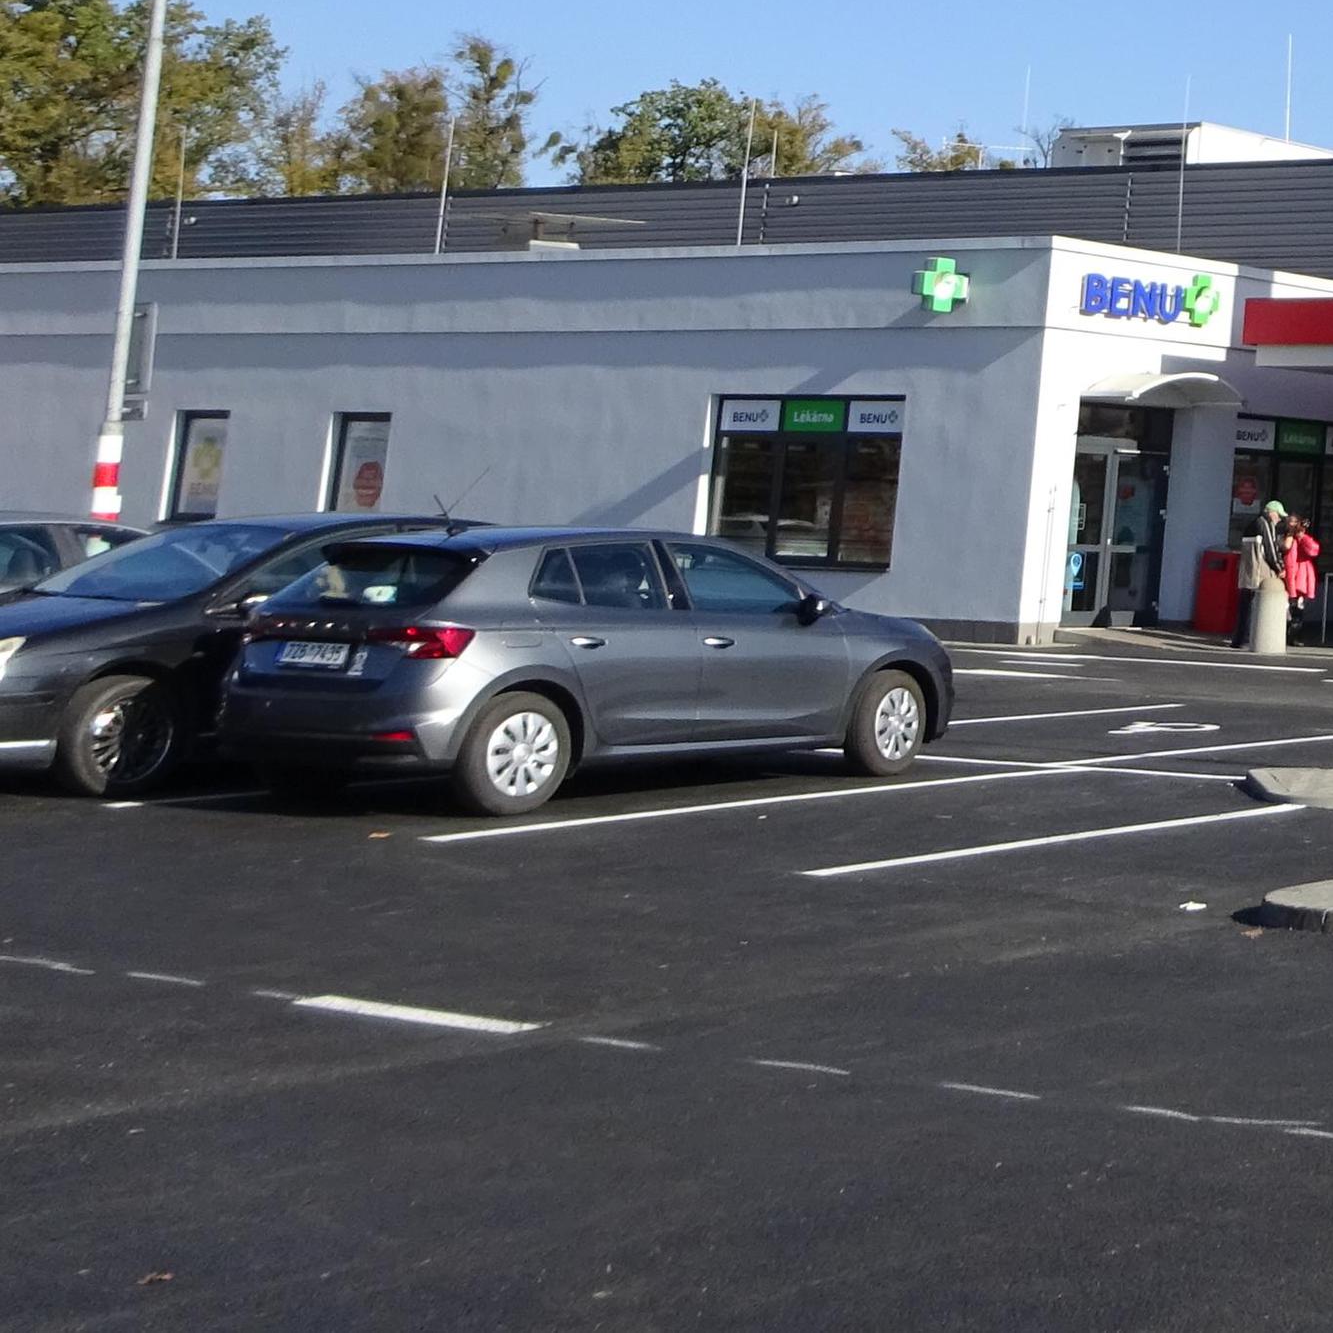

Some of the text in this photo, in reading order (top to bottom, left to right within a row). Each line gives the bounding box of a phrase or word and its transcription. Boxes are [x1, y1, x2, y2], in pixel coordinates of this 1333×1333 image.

[1081, 272, 1184, 324] BENU
[732, 411, 759, 423] BENU
[793, 410, 834, 423] Lékárna
[859, 412, 888, 424] BENU
[1236, 429, 1259, 442] BENU
